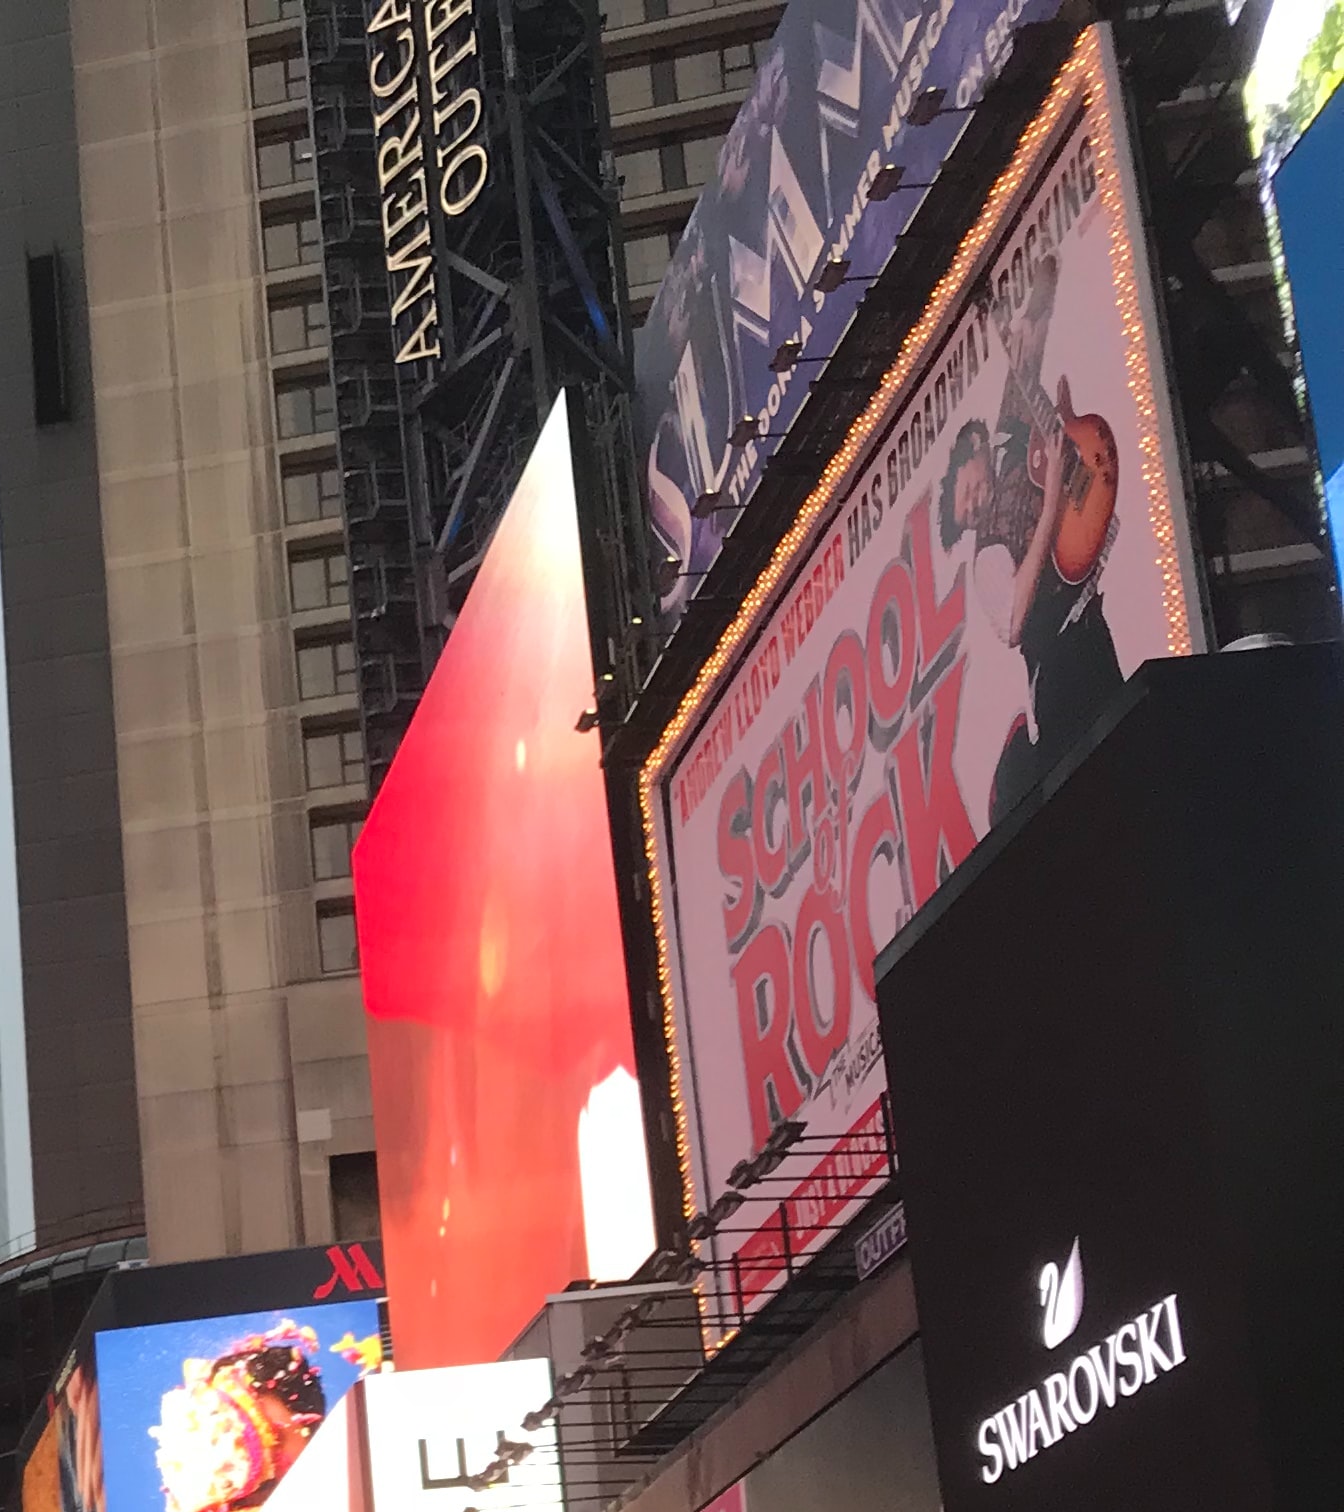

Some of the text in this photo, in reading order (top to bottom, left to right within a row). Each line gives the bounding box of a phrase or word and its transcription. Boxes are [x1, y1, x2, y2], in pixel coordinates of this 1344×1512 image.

[717, 500, 968, 950] SCHOOL
[735, 636, 782, 742] LLOYD
[779, 533, 846, 667] WEBBER
[846, 483, 886, 568] HAS
[887, 304, 990, 507] BROADWAY
[730, 652, 984, 1160] ROCK
[976, 1293, 1188, 1486] SWAROVSKI
